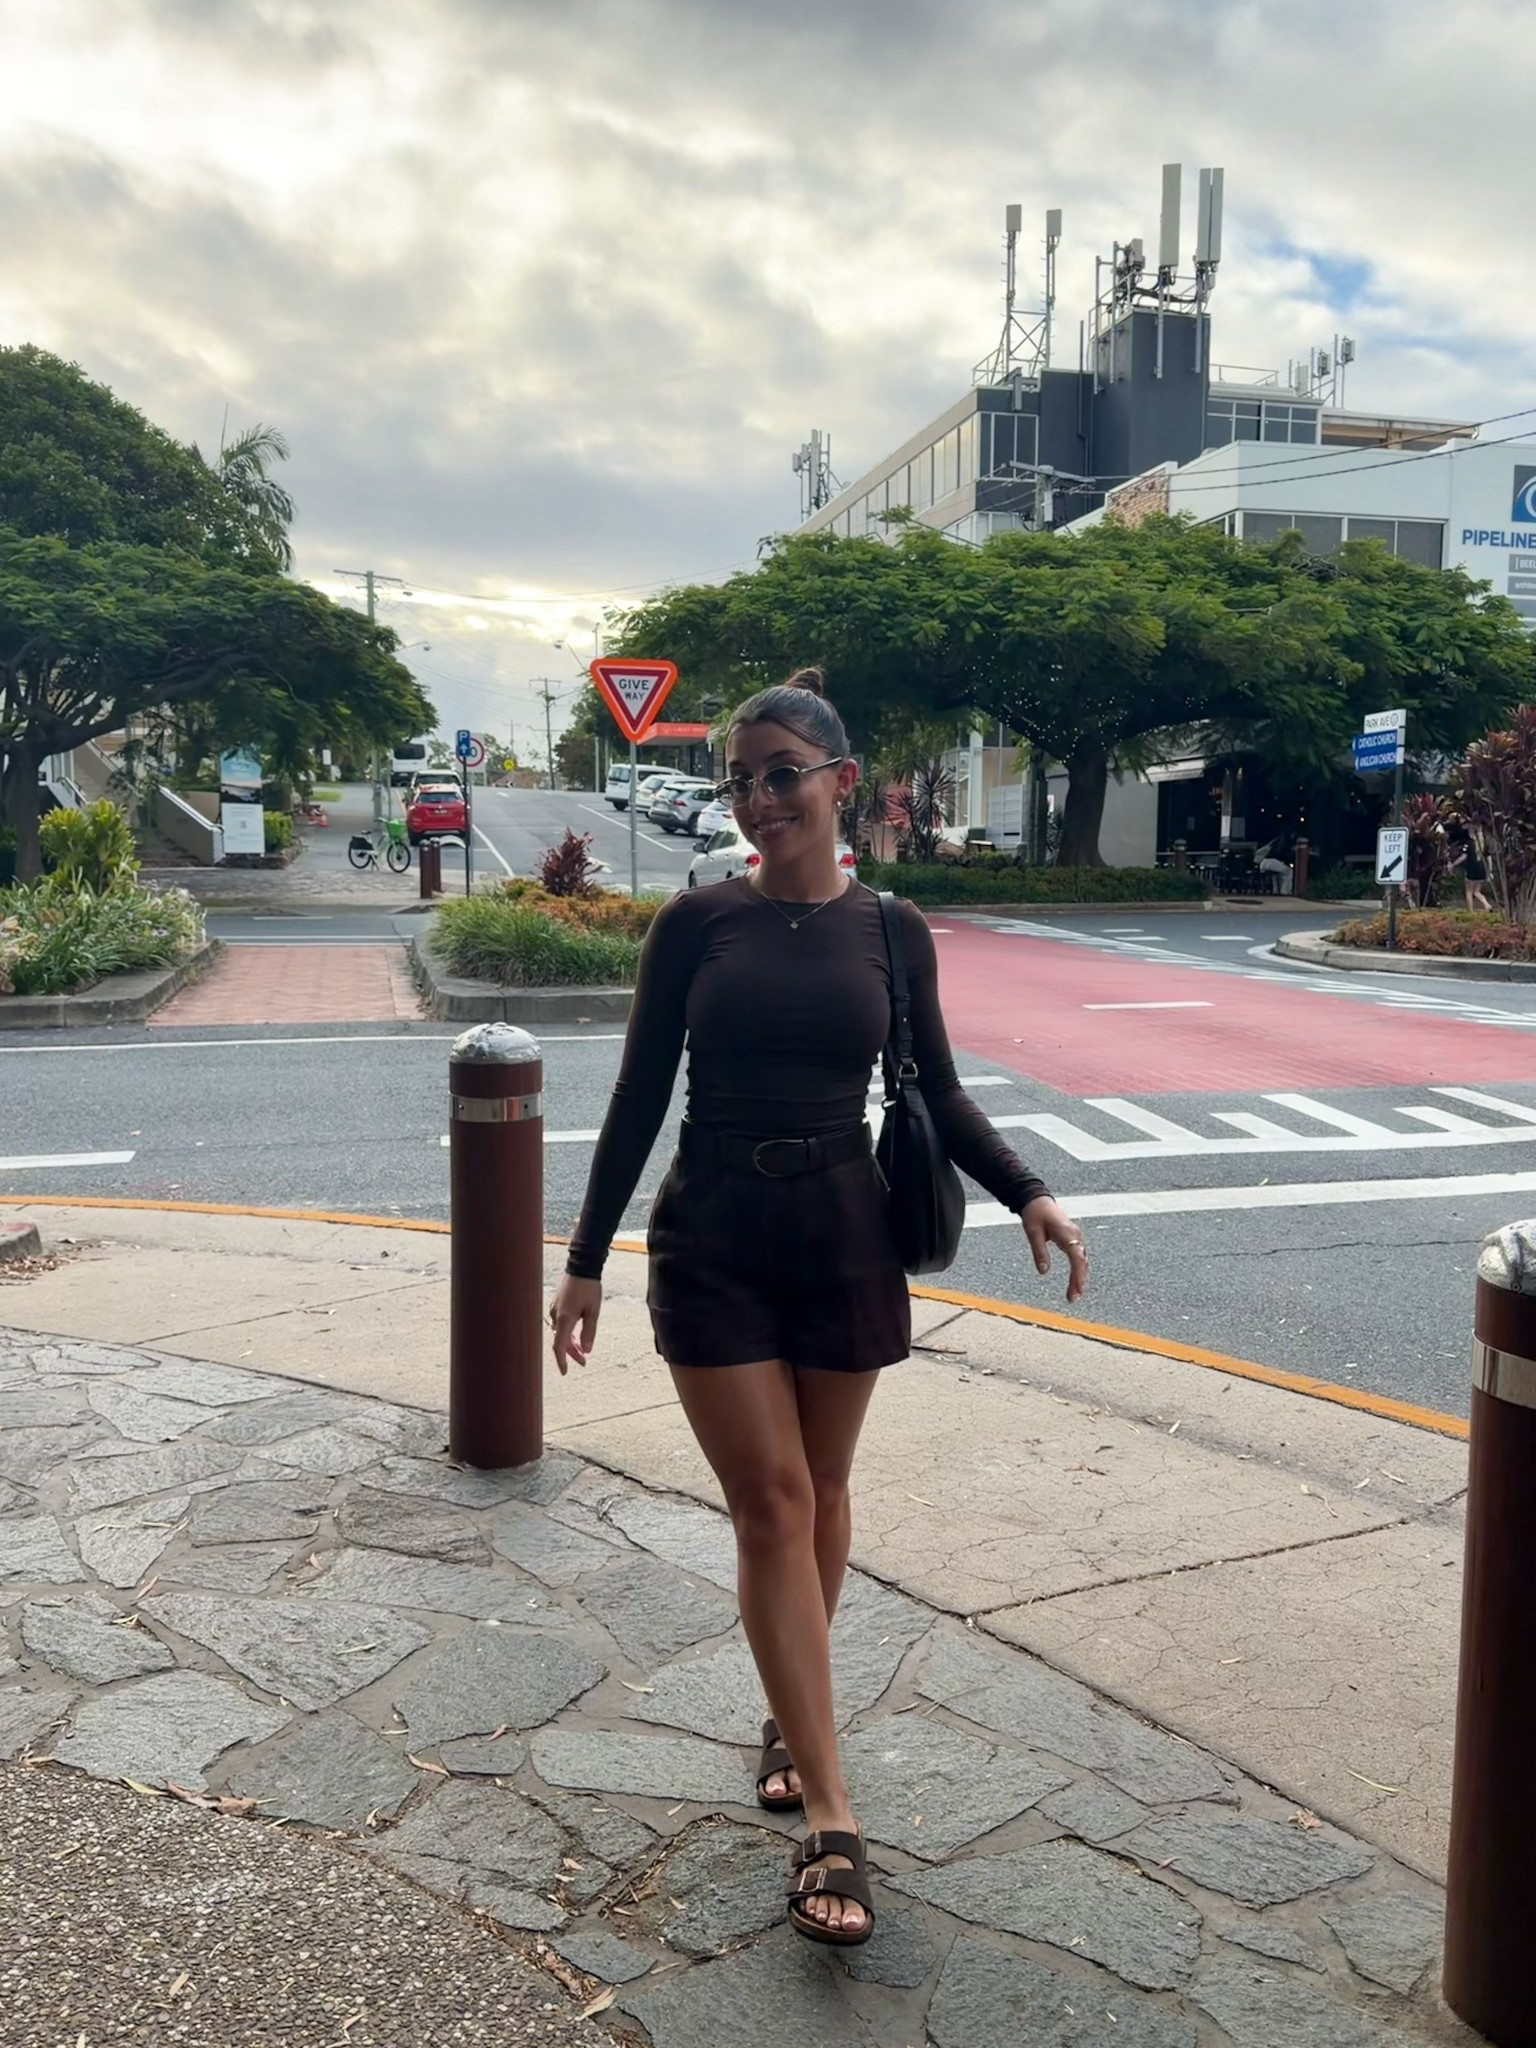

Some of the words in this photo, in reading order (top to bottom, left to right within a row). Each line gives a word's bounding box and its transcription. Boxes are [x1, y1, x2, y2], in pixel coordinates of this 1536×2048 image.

[1462, 529, 1536, 549] PIPELINE
[618, 679, 649, 690] GIVE
[625, 692, 644, 700] WAY
[1366, 718, 1379, 728] PARK
[459, 731, 468, 741] P
[1377, 733, 1396, 745] CHURCH
[1384, 833, 1403, 842] KEEP
[1384, 844, 1401, 853] LEFT
